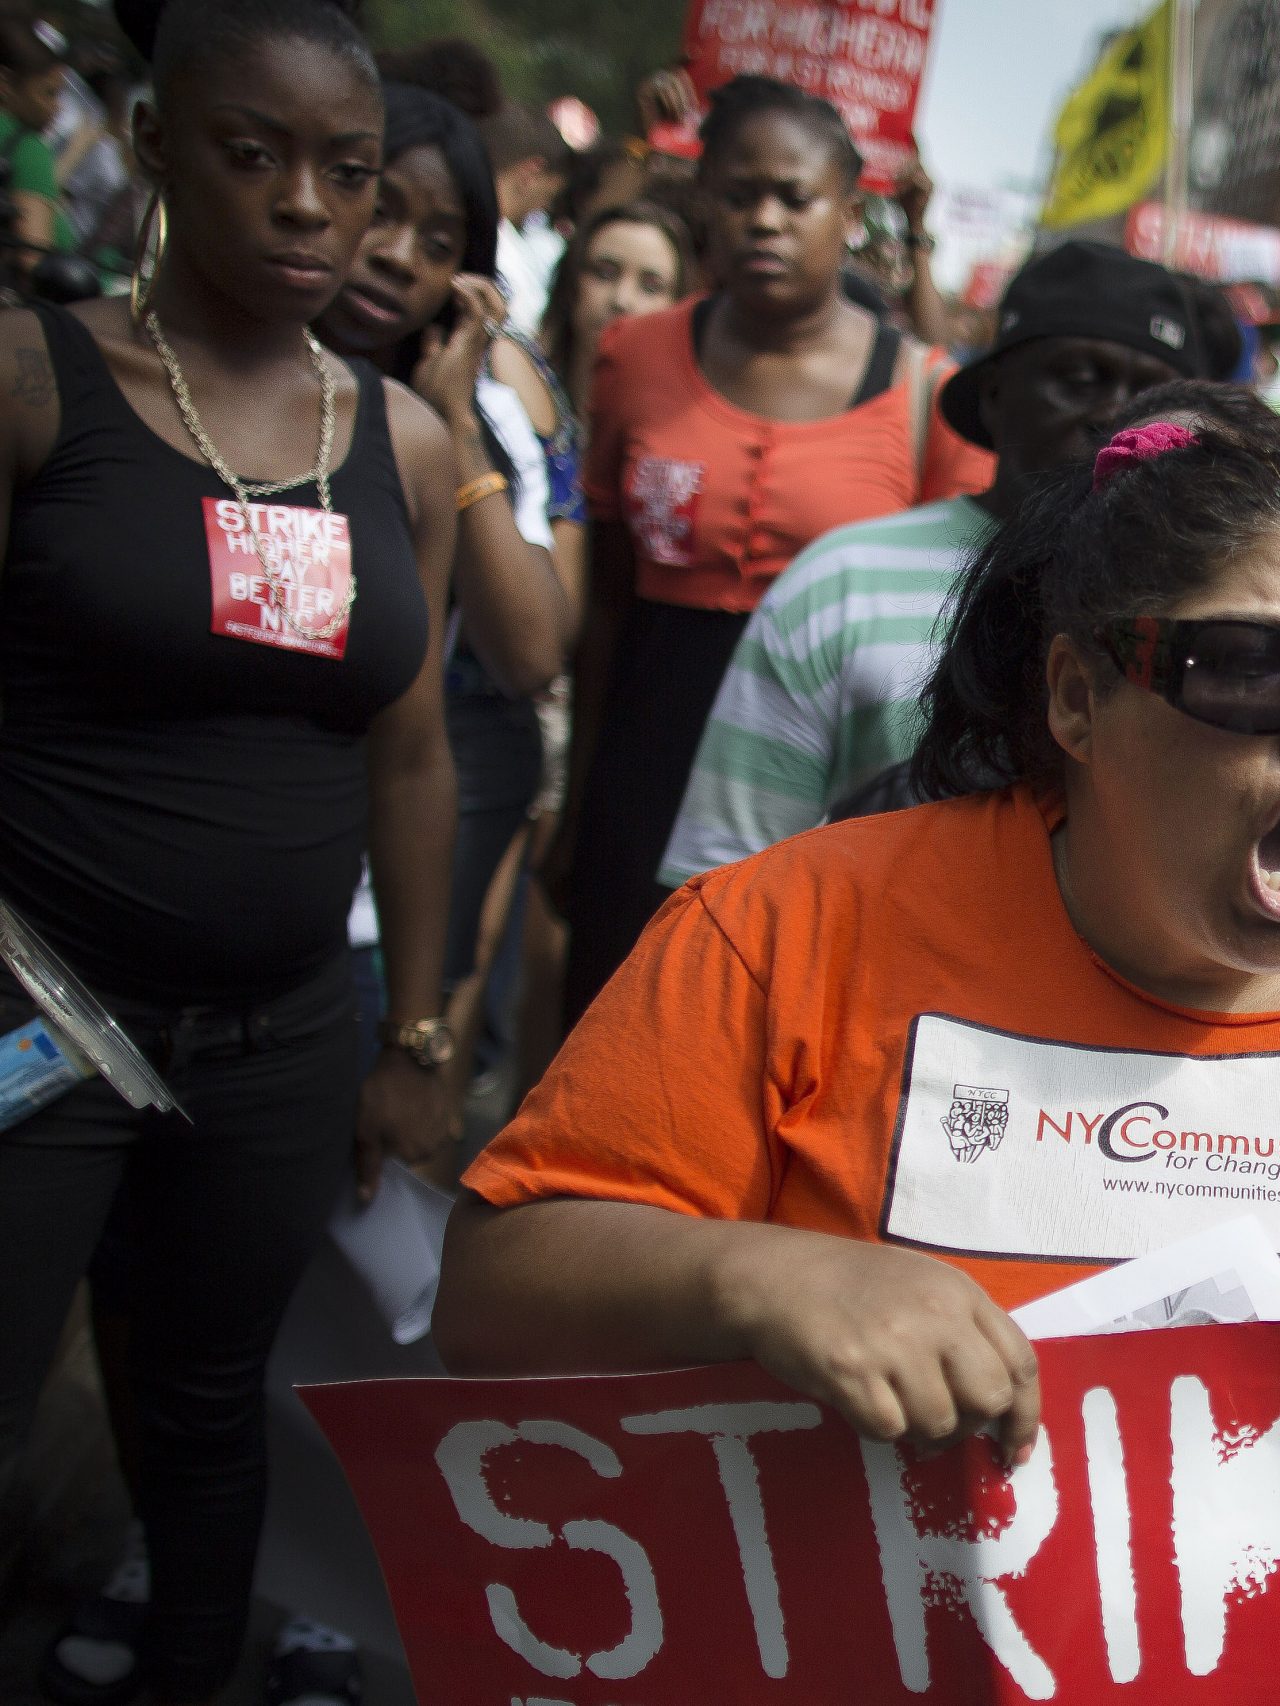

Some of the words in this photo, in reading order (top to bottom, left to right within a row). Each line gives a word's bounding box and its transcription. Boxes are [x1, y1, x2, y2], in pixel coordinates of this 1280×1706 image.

[215, 500, 351, 551] STRIKE
[227, 532, 331, 568] HIGHER
[229, 571, 335, 617] BETTER
[1165, 1150, 1198, 1170] for
